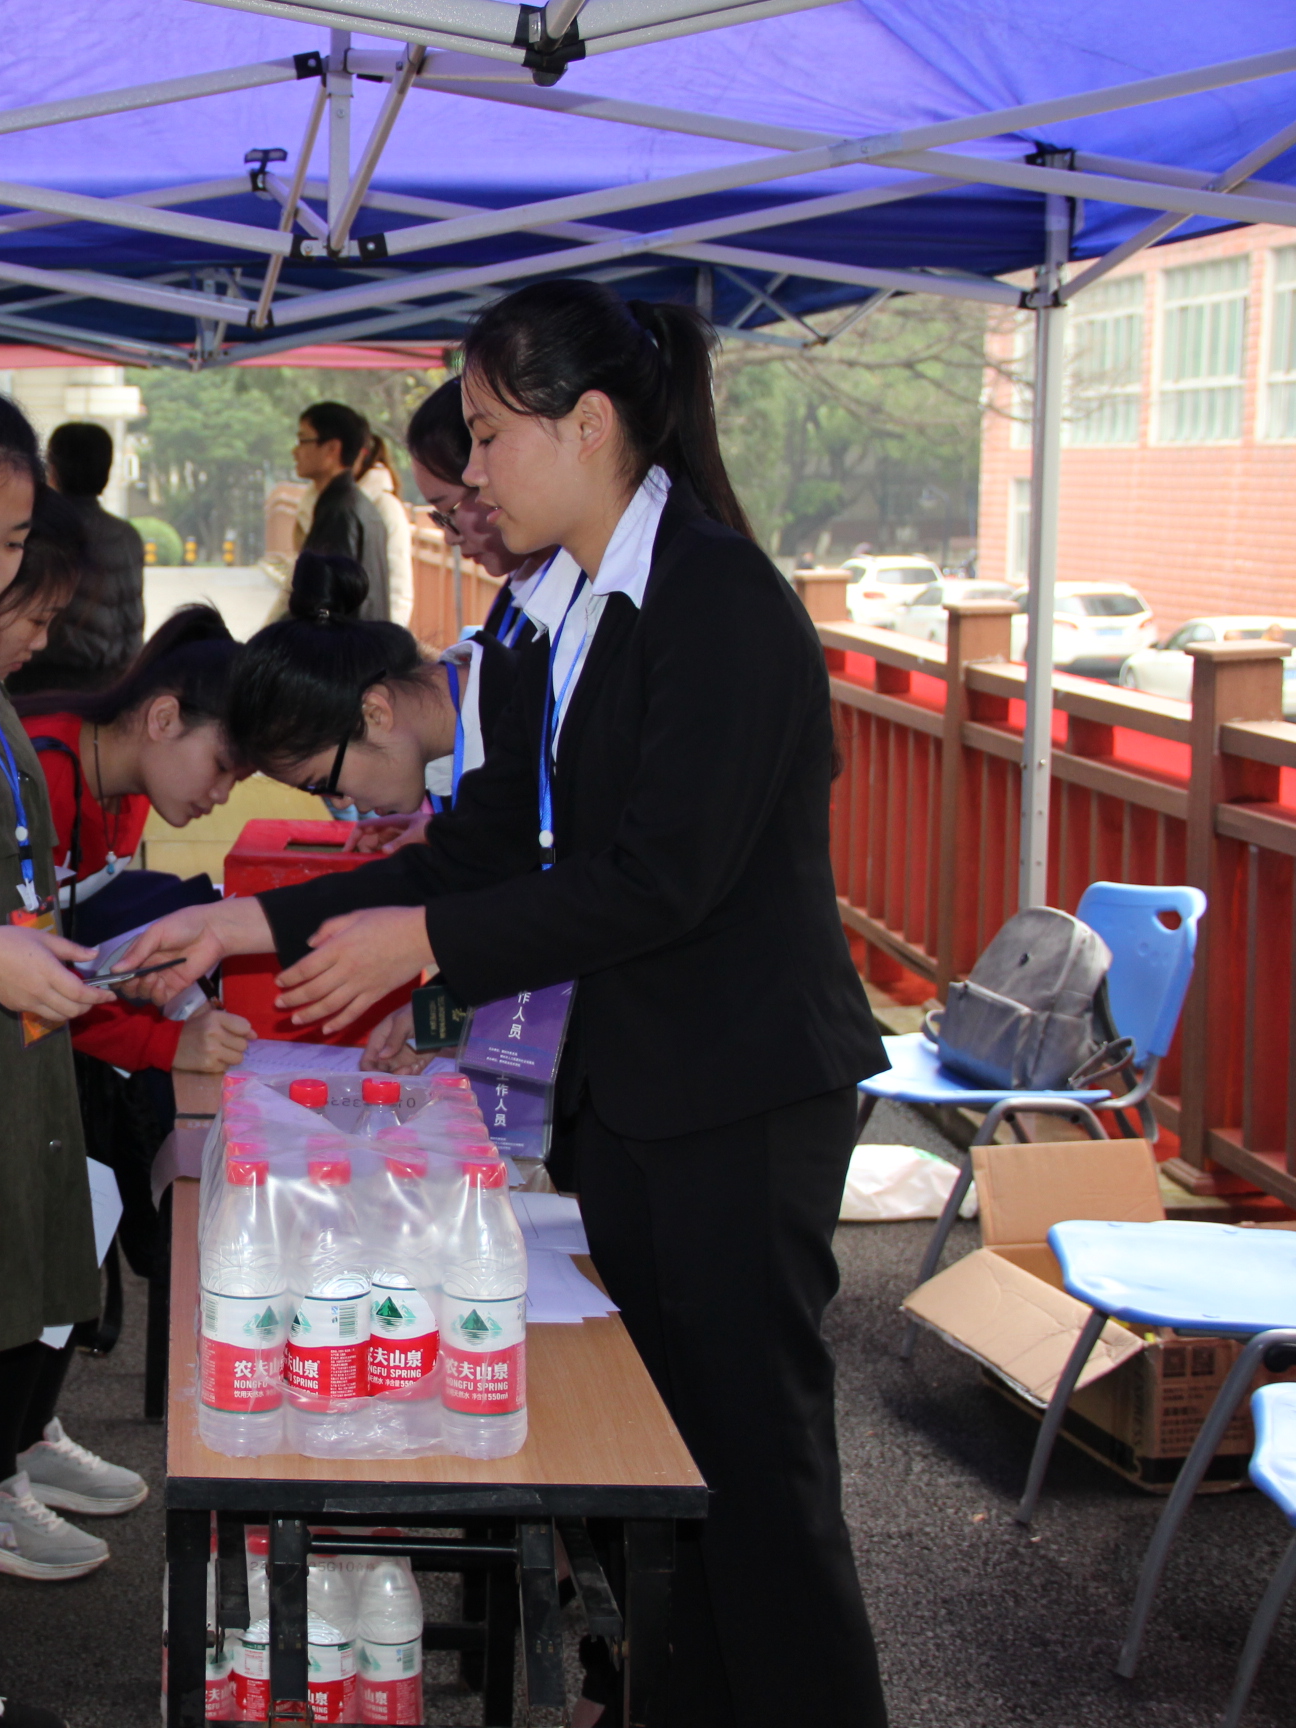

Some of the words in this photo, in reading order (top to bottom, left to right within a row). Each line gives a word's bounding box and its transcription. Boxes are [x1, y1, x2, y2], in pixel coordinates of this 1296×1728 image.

[390, 1368, 422, 1378] SPRING
[445, 1358, 509, 1381] 农夫山泉
[292, 1374, 319, 1389] SPRING
[476, 1382, 508, 1392] SPRING
